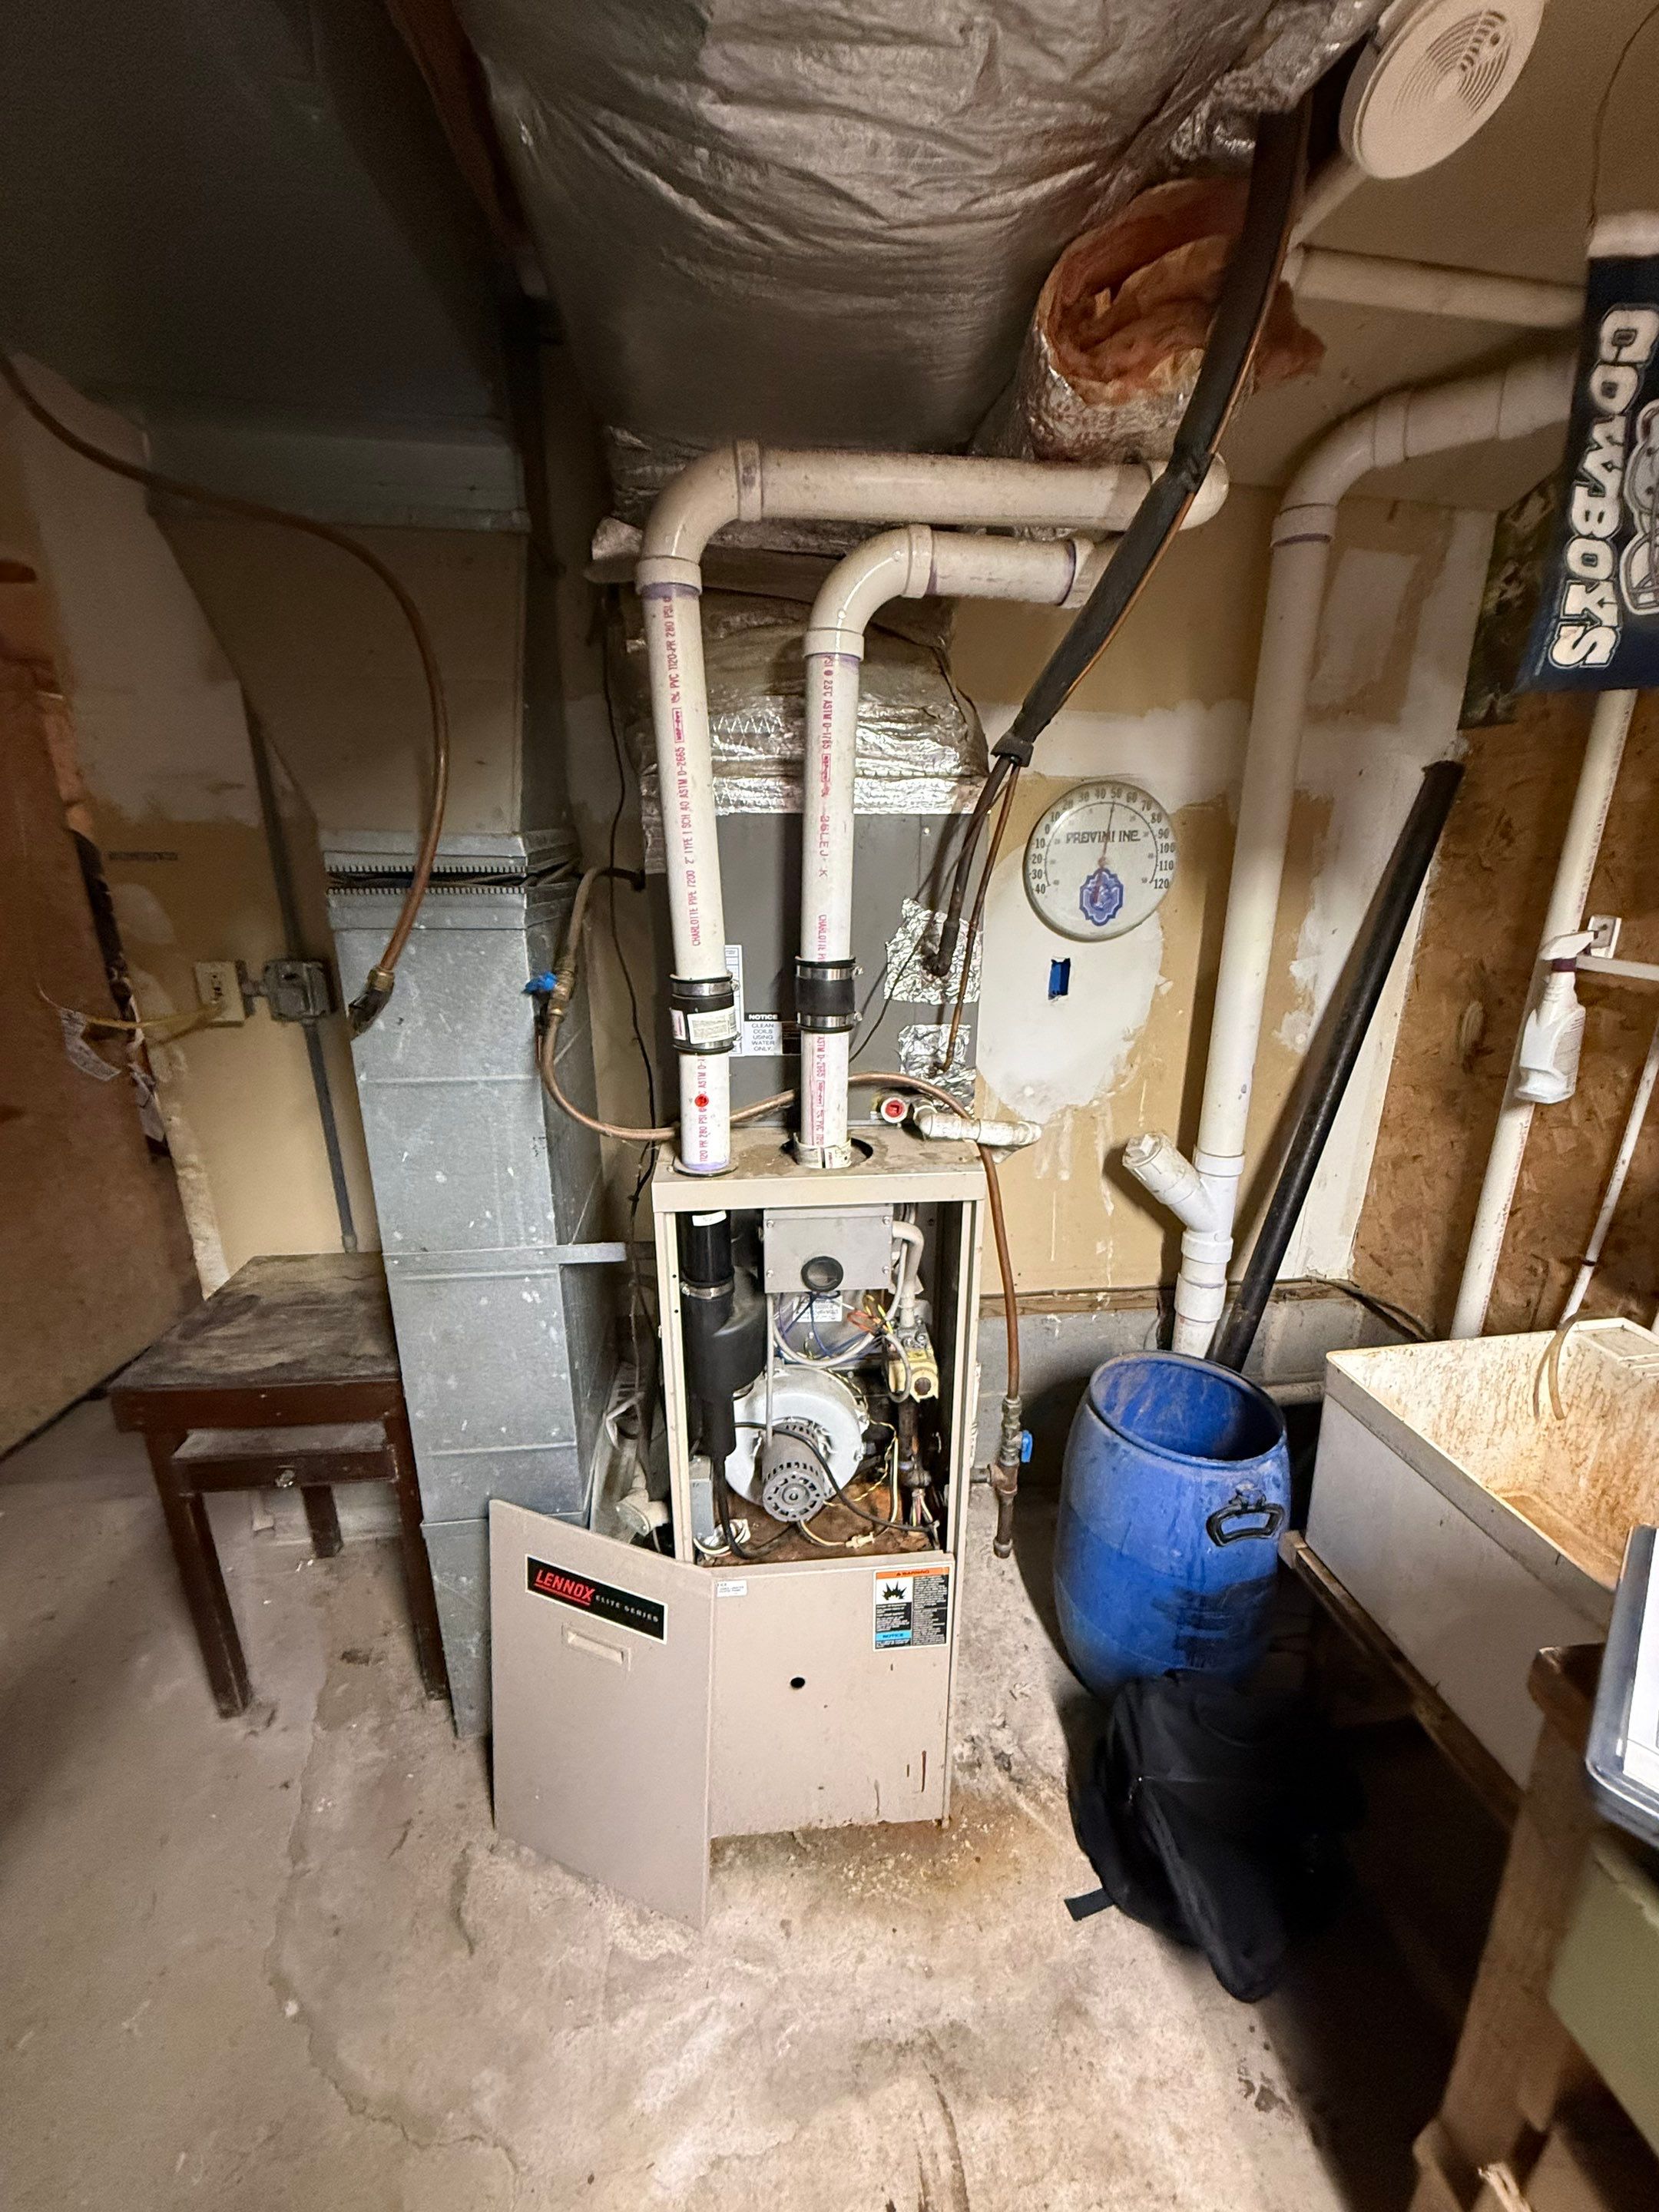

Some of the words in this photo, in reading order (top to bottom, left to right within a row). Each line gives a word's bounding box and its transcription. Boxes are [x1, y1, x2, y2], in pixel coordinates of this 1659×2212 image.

[1549, 304, 1659, 668] COWBOYS
[665, 621, 674, 637] 280
[670, 674, 680, 688] PVC
[823, 700, 833, 720] ASTM
[823, 723, 832, 750] D-1785
[677, 747, 687, 776] D-2665
[678, 779, 688, 798] ASTM
[680, 801, 690, 811] 40
[682, 814, 691, 828] SCH
[1151, 813, 1162, 823] 80
[1158, 828, 1169, 839] 90
[1160, 842, 1176, 853] 100
[1159, 860, 1174, 871] 110
[1154, 878, 1169, 889] 120
[688, 890, 697, 905] PIPE
[690, 908, 700, 946] CHARLOTTE
[818, 914, 827, 951] CHARLOTTE
[698, 1071, 707, 1088] ASTM
[699, 1126, 707, 1137] 280
[535, 1569, 595, 1602] LENNOX
[595, 1594, 621, 1608] ELITE
[624, 1605, 659, 1623] SERIES
